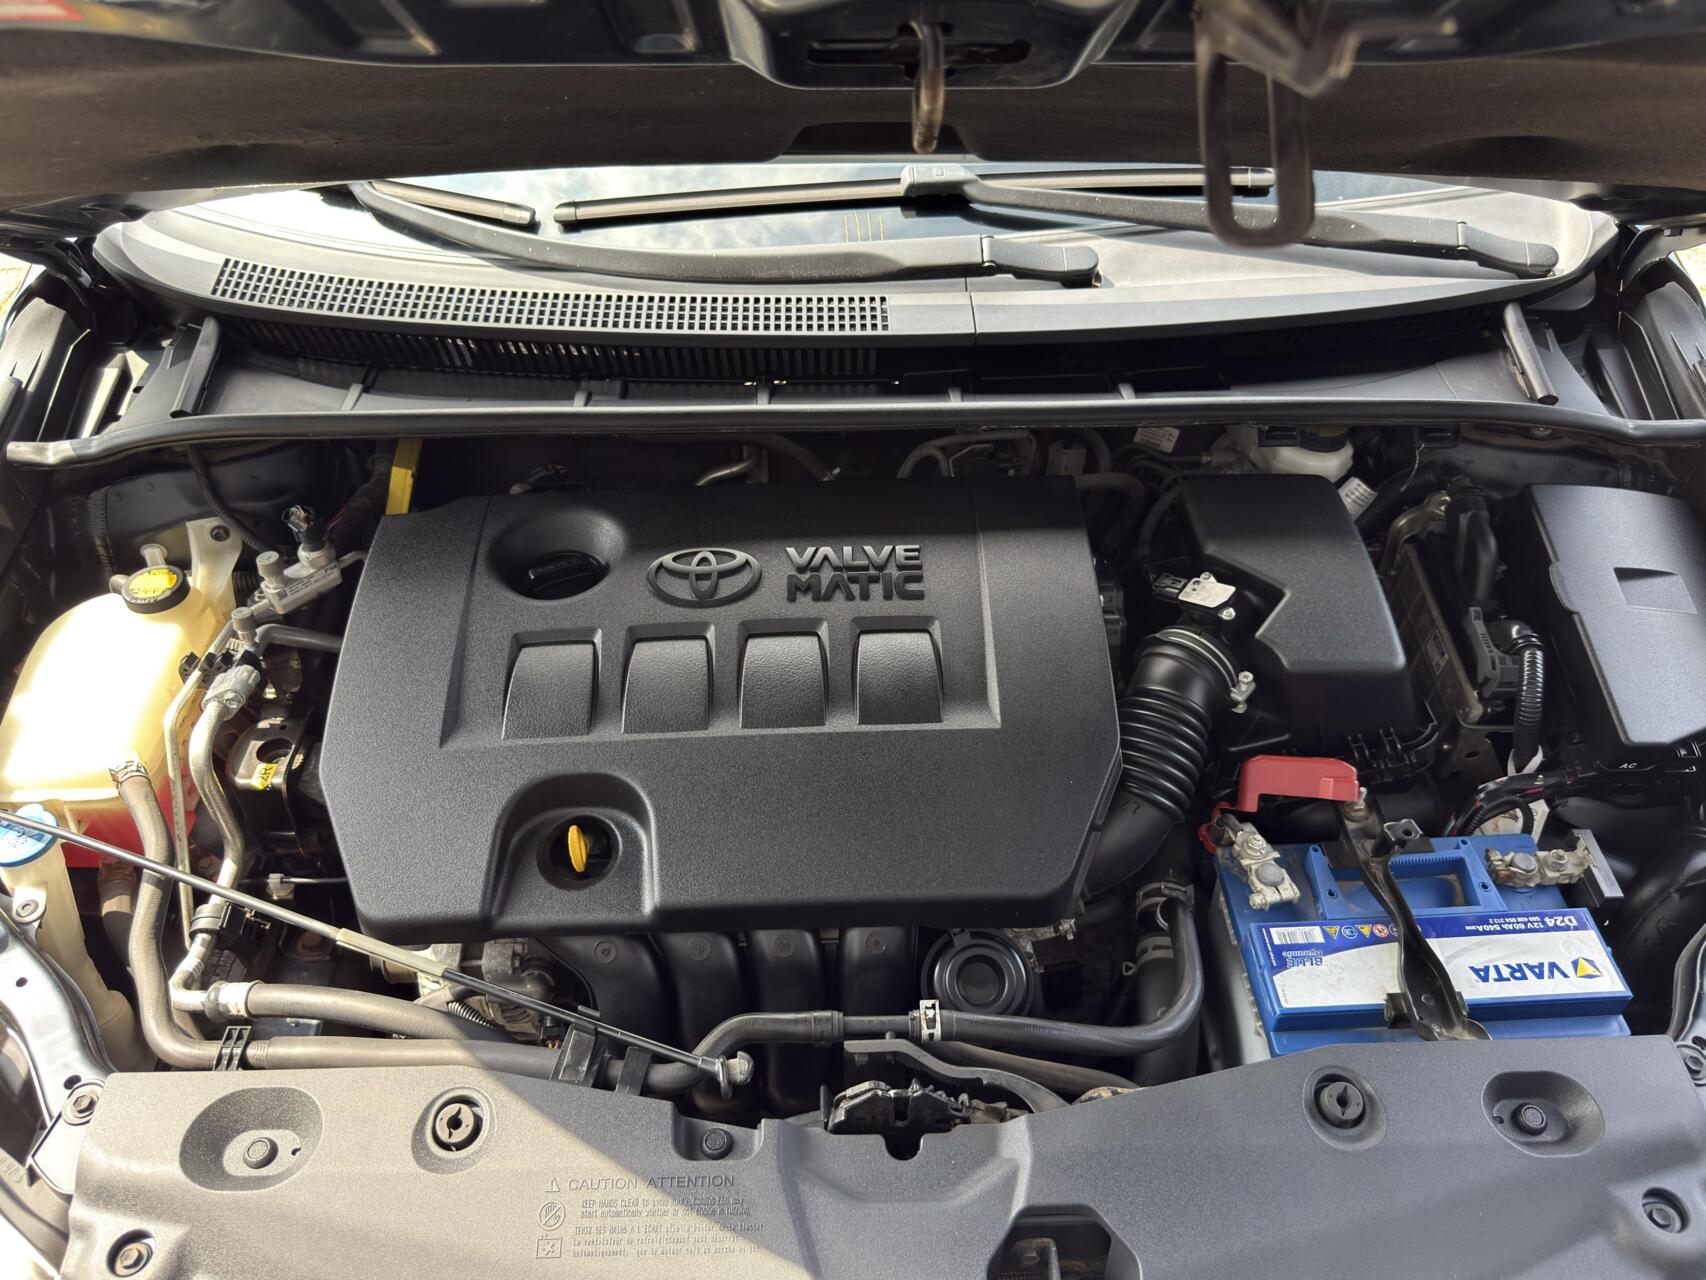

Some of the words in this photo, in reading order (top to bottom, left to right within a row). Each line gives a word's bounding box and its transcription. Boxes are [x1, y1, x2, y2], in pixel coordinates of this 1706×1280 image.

[786, 545, 923, 571] VALVE
[786, 570, 925, 603] MATIC
[1527, 921, 1544, 929] 12V
[1544, 915, 1578, 928] D24
[1286, 957, 1323, 969] BLUE
[1468, 960, 1569, 983] VARTA
[568, 1177, 638, 1191] CAUTION
[646, 1174, 736, 1189] ATTENTION
[620, 1198, 640, 1207] CLEAR
